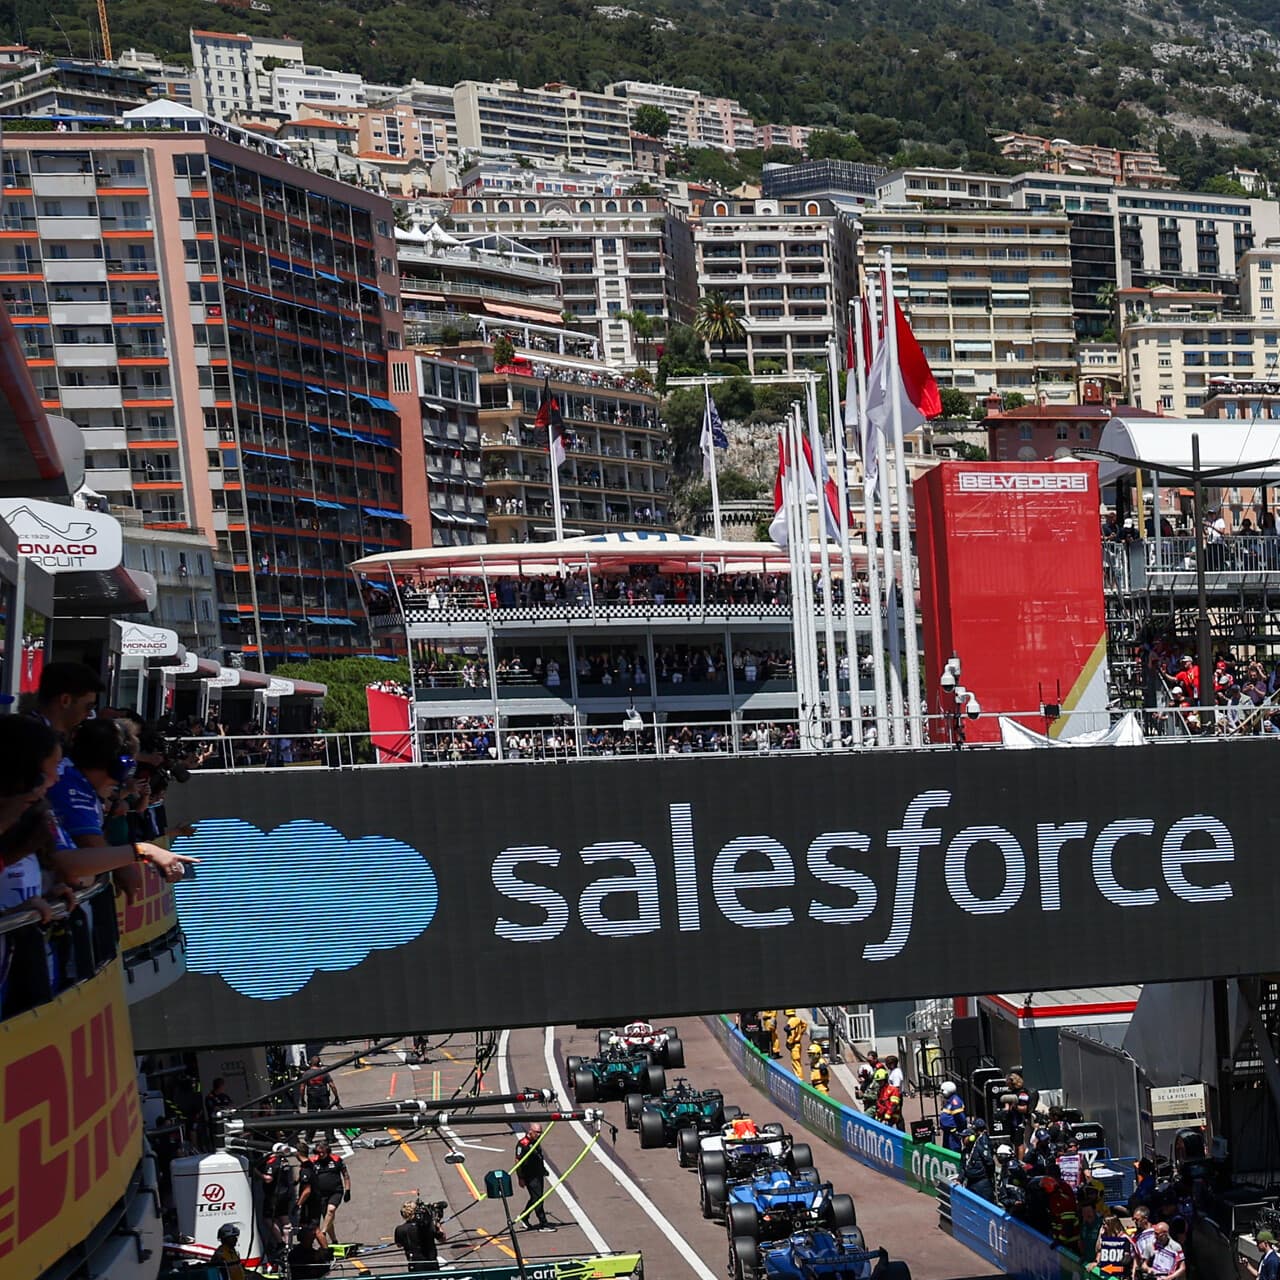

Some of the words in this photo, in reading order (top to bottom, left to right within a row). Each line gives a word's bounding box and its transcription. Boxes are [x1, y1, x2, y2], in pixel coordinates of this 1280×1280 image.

[962, 475, 1084, 489] BELVEDERE
[17, 543, 97, 555] ONACO
[29, 555, 85, 568] RCUIT
[491, 788, 1236, 962] salesforce
[4, 1003, 129, 1246] DHL
[847, 1120, 894, 1166] aramco
[195, 1202, 236, 1213] TGR
[1101, 1248, 1124, 1263] BOX
